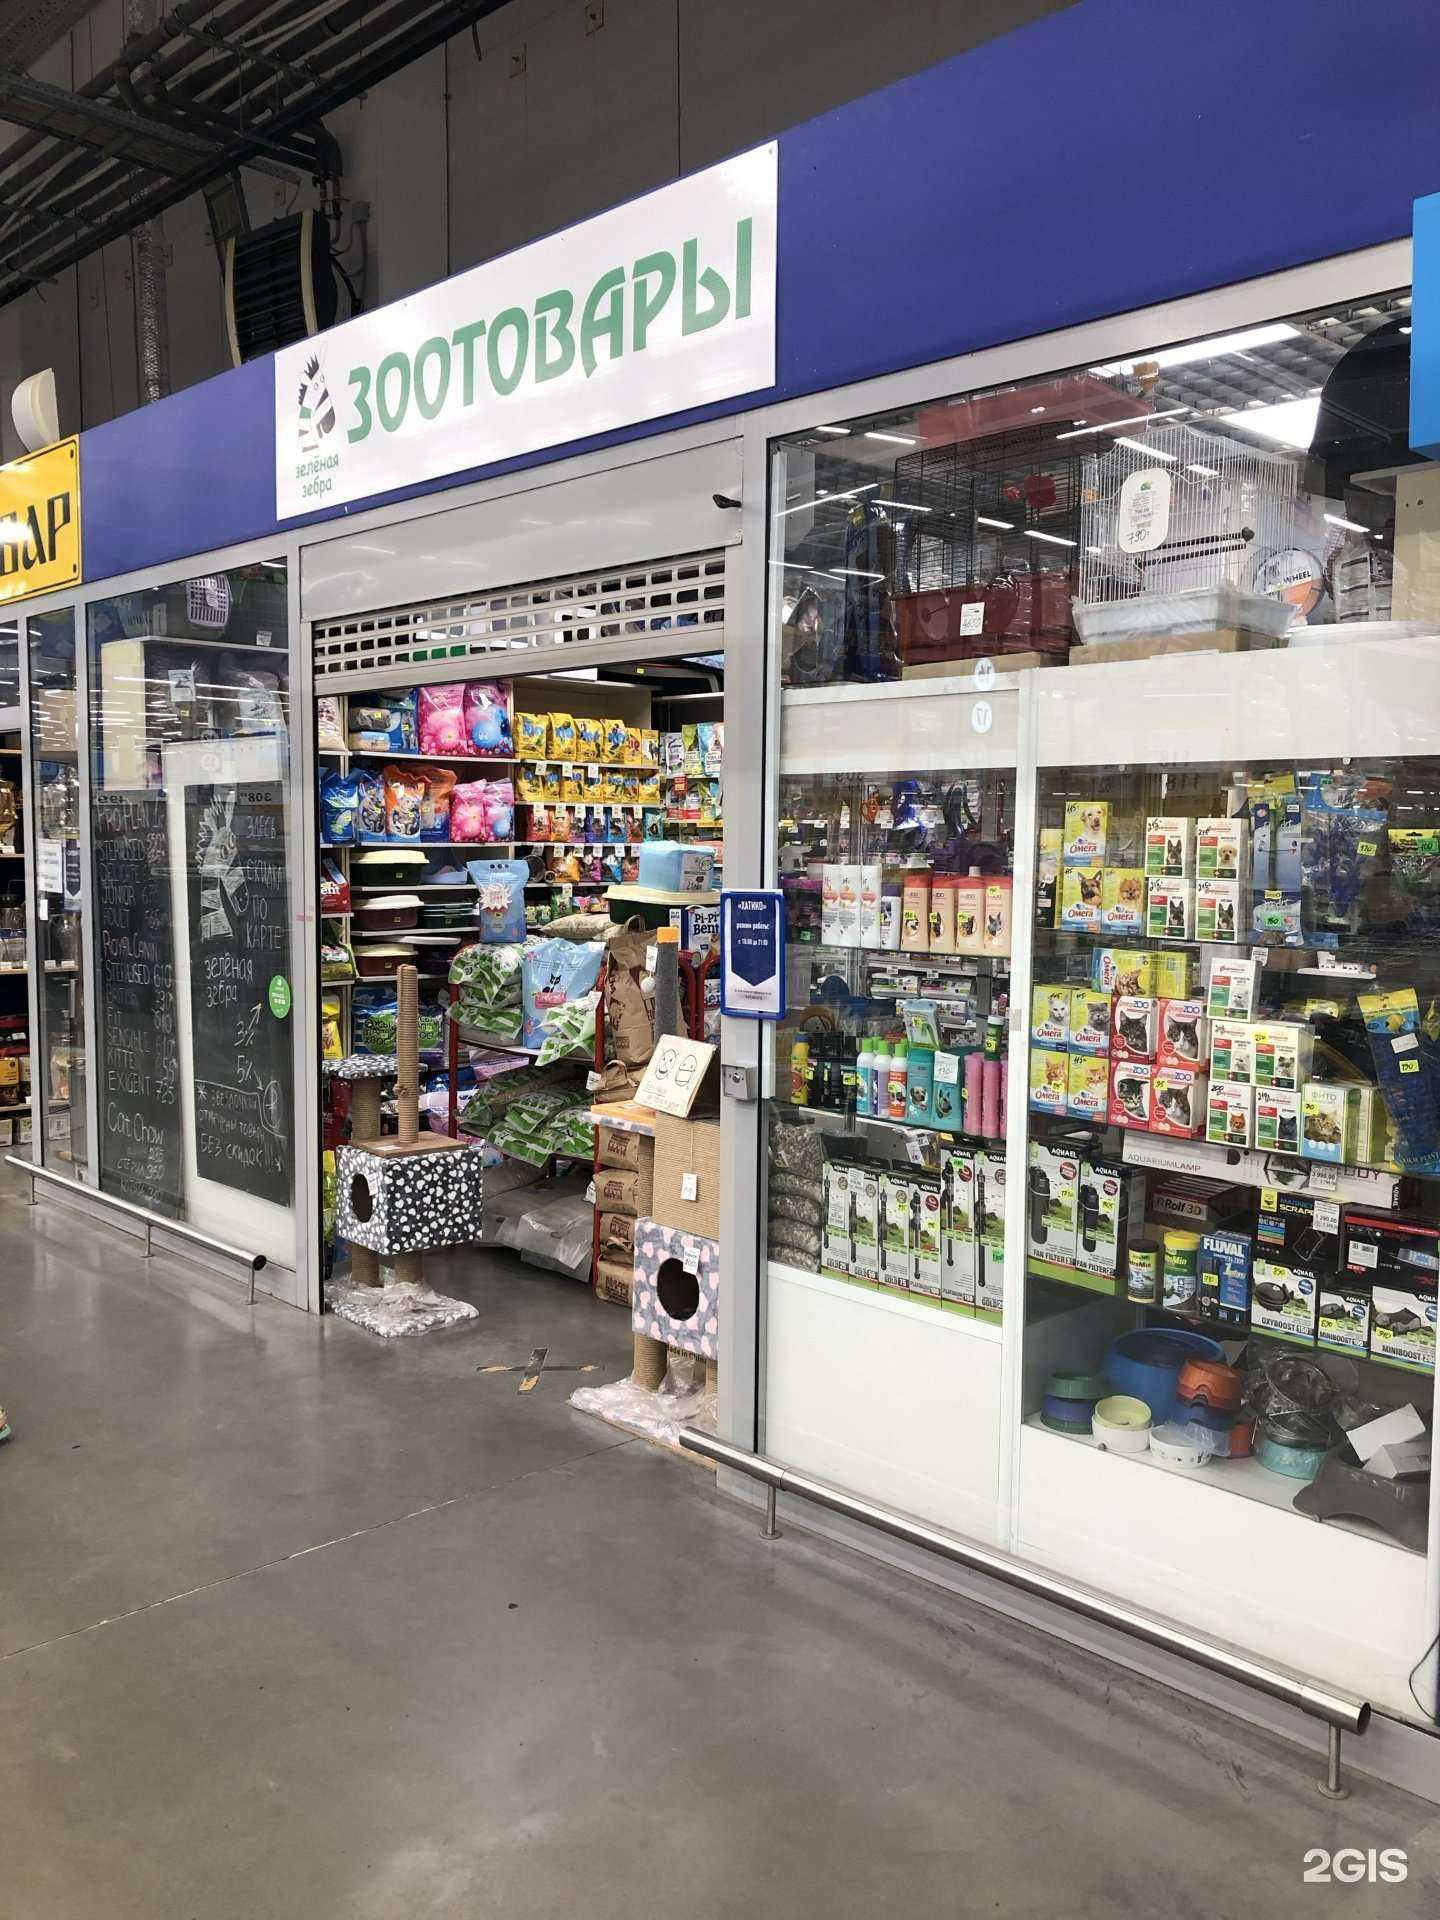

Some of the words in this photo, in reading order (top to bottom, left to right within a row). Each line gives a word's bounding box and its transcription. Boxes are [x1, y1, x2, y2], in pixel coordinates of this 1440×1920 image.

[347, 217, 752, 444] ЗООТОВАРЫ
[295, 449, 339, 480] зелёная
[302, 474, 333, 498] зебра
[1283, 570, 1311, 584] WHEEL
[694, 912, 720, 924] Pi-Pi
[246, 921, 282, 951] КАРТЕ
[694, 923, 720, 935] Bent
[206, 981, 238, 1009] зебра
[1133, 1000, 1149, 1009] ZOO
[1183, 1005, 1200, 1014] ZOO
[1133, 1066, 1149, 1074] ZOO
[1175, 1071, 1192, 1081] ZOO
[1051, 1147, 1077, 1159] AQUAEL
[1095, 1166, 1119, 1177] AQUAEL
[1165, 1198, 1186, 1212] Rolf
[1187, 1205, 1202, 1215] 3D
[1203, 1238, 1245, 1257] FLUVAL
[1034, 1249, 1044, 1258] FAN
[1046, 1250, 1065, 1263] FILTER
[1076, 1260, 1086, 1270] FAN
[1088, 1262, 1107, 1273] FILTER
[1293, 1268, 1315, 1279] AQUAEL
[1261, 1317, 1294, 1331] OXYBOOST
[1382, 1345, 1421, 1360] MINIBOOST
